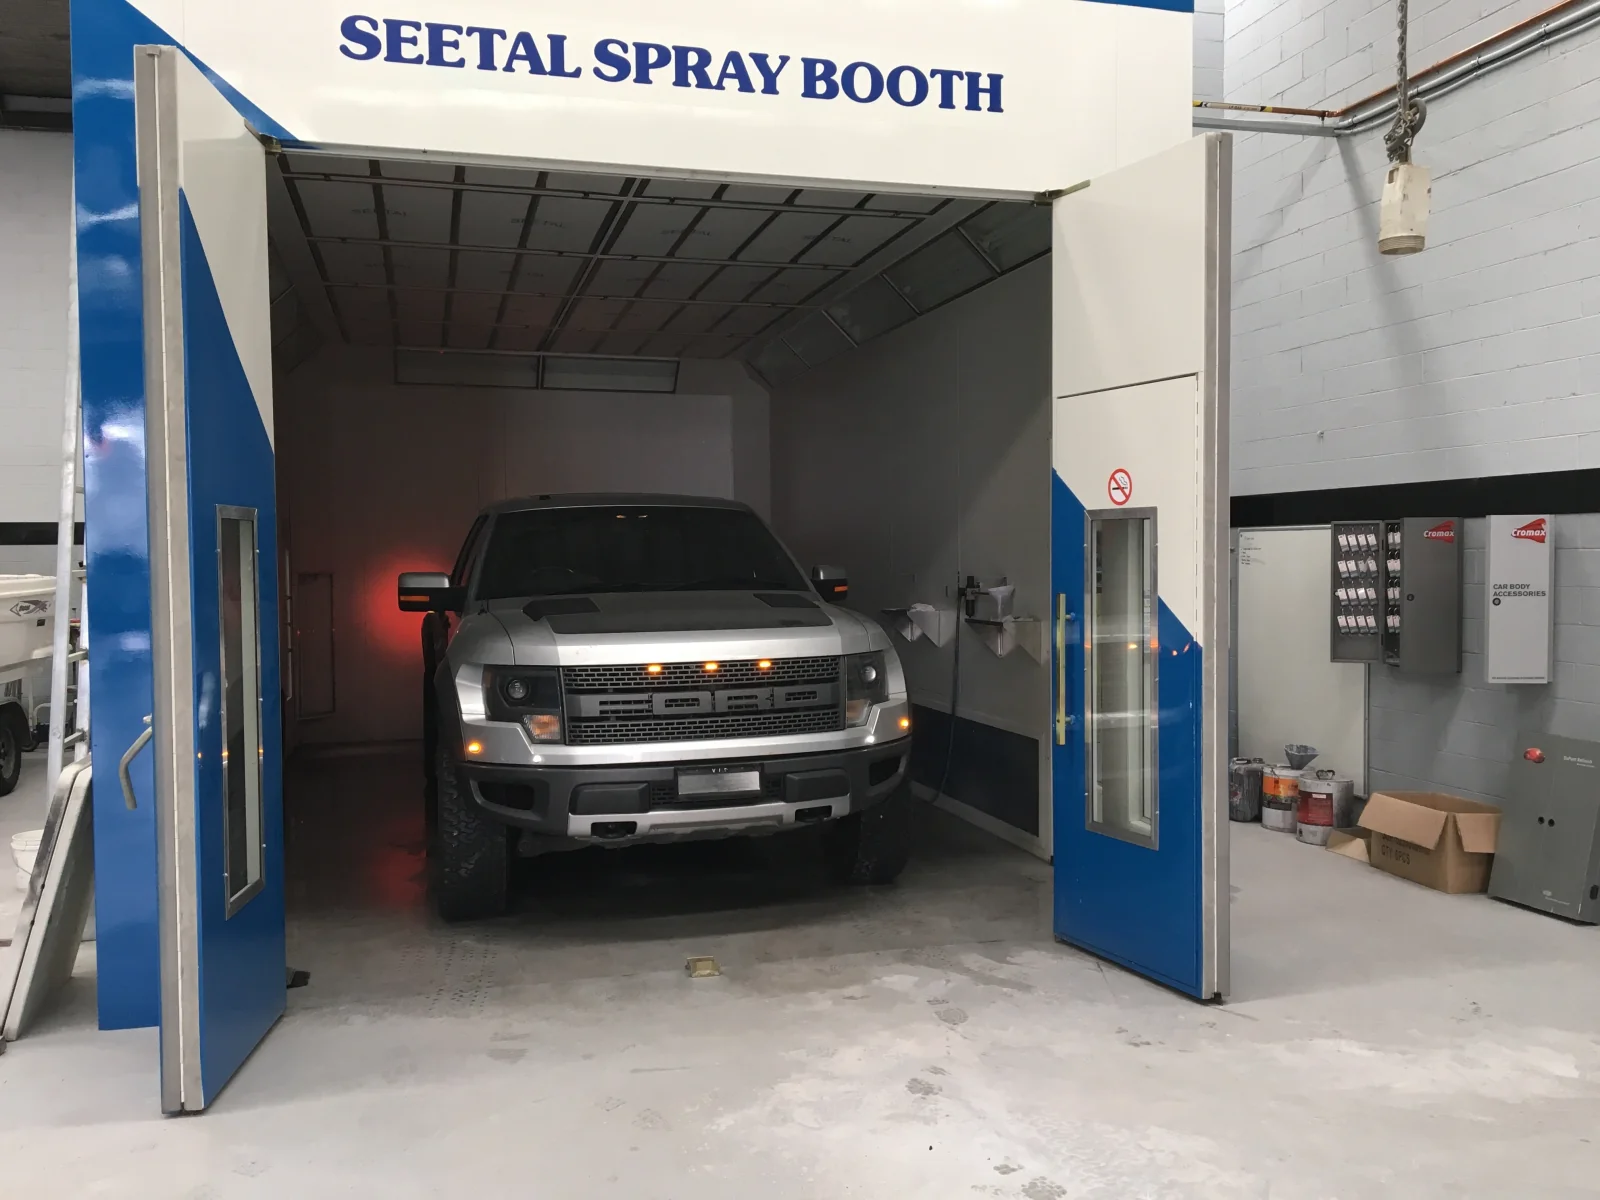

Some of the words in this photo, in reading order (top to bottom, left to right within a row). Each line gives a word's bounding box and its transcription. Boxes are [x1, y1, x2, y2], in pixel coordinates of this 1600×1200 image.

[340, 15, 581, 78] SEETAL
[593, 39, 789, 95] SPRAY
[801, 57, 1003, 113] BOOTH
[1423, 530, 1455, 538] Cromax
[1511, 528, 1546, 537] Cromax
[567, 682, 838, 717] FORD
